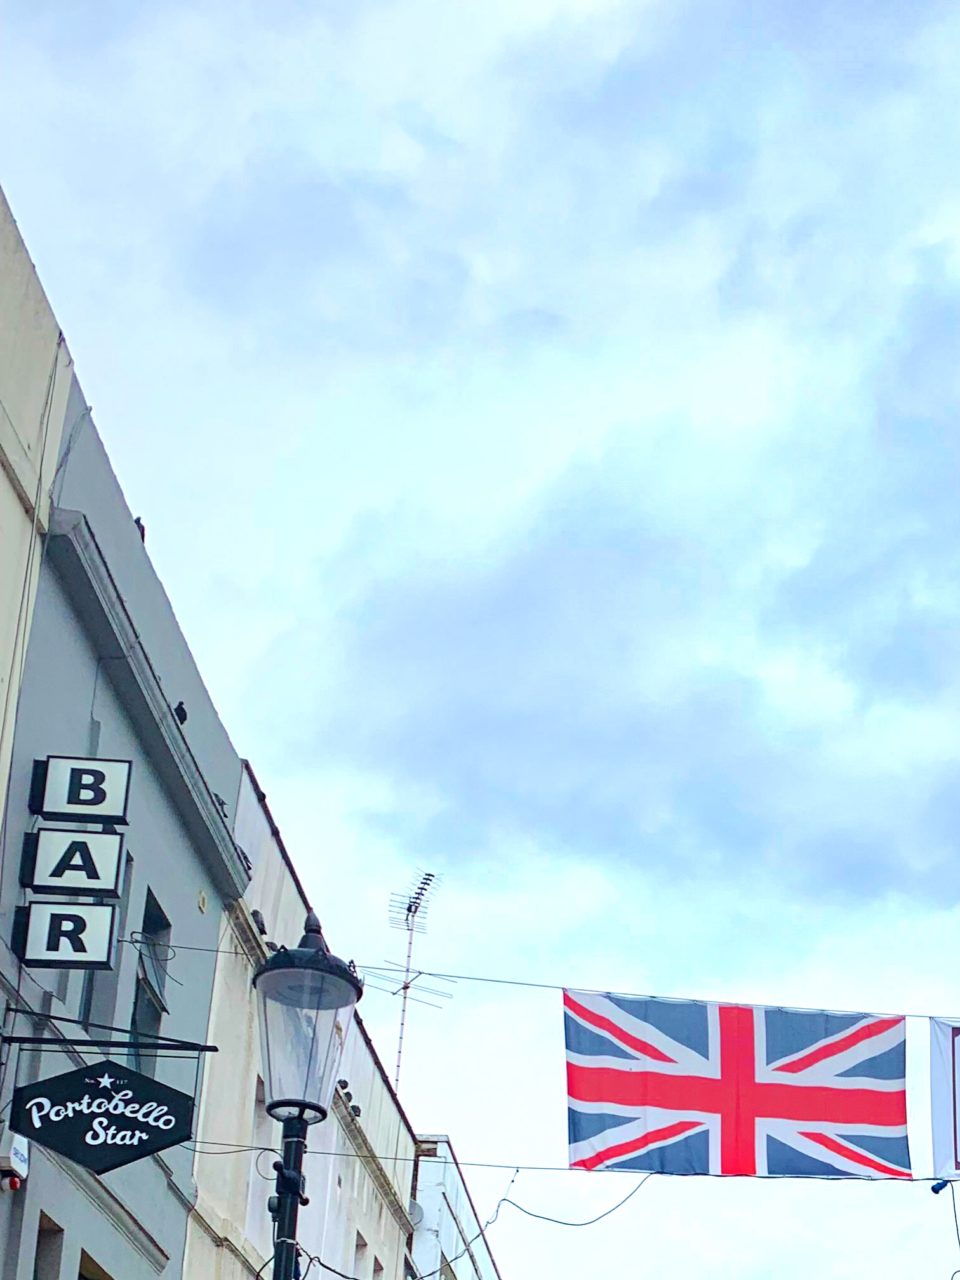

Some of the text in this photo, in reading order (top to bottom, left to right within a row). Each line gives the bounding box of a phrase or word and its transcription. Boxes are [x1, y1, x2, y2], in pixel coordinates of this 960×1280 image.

[45, 768, 107, 954] BAR
[25, 1090, 176, 1130] Portobello
[85, 1117, 149, 1146] Star
